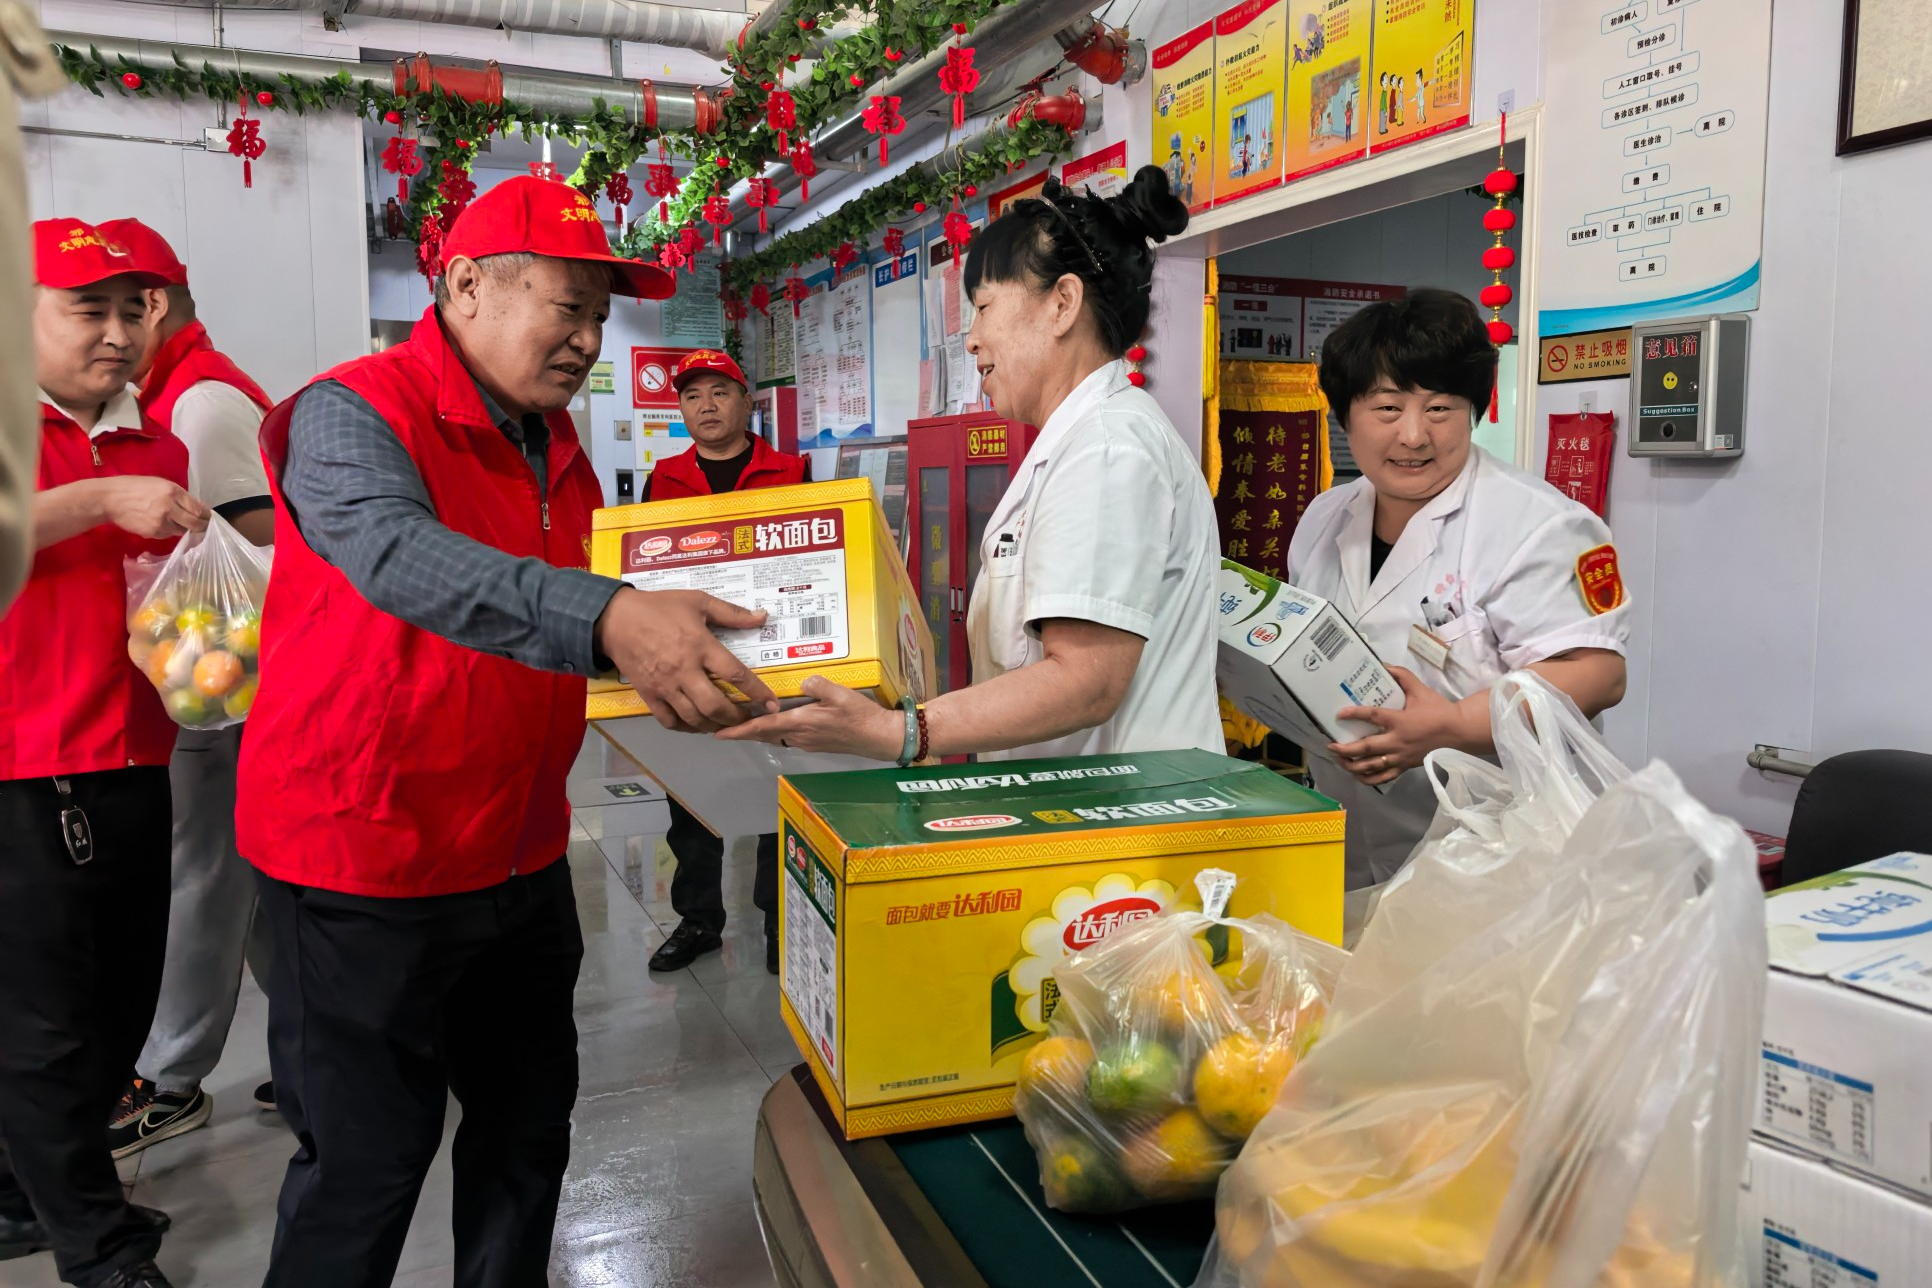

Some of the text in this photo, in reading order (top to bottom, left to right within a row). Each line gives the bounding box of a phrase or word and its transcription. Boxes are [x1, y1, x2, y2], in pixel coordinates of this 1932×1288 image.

[1610, 10, 1638, 27] 初诊病人
[1637, 33, 1666, 49] 预检分诊
[1617, 61, 1683, 90] 人工窗口取号、挂号
[1613, 91, 1686, 121] 各诊区签到、排队候诊
[1633, 134, 1662, 150] 医生诊治
[1571, 228, 1598, 241] 医技检查
[1574, 338, 1628, 361] 禁止吸烟
[1645, 335, 1698, 360] 意见箱
[1573, 358, 1627, 370] NO SMOKING
[1643, 407, 1681, 415] Suggestion
[1556, 437, 1590, 451] 灭火毯
[680, 534, 718, 548] Dalezz
[736, 528, 751, 551] 法式
[755, 517, 838, 552] 软面包
[1073, 796, 1238, 820] 软面包
[885, 888, 1022, 927] 面包就要达利园
